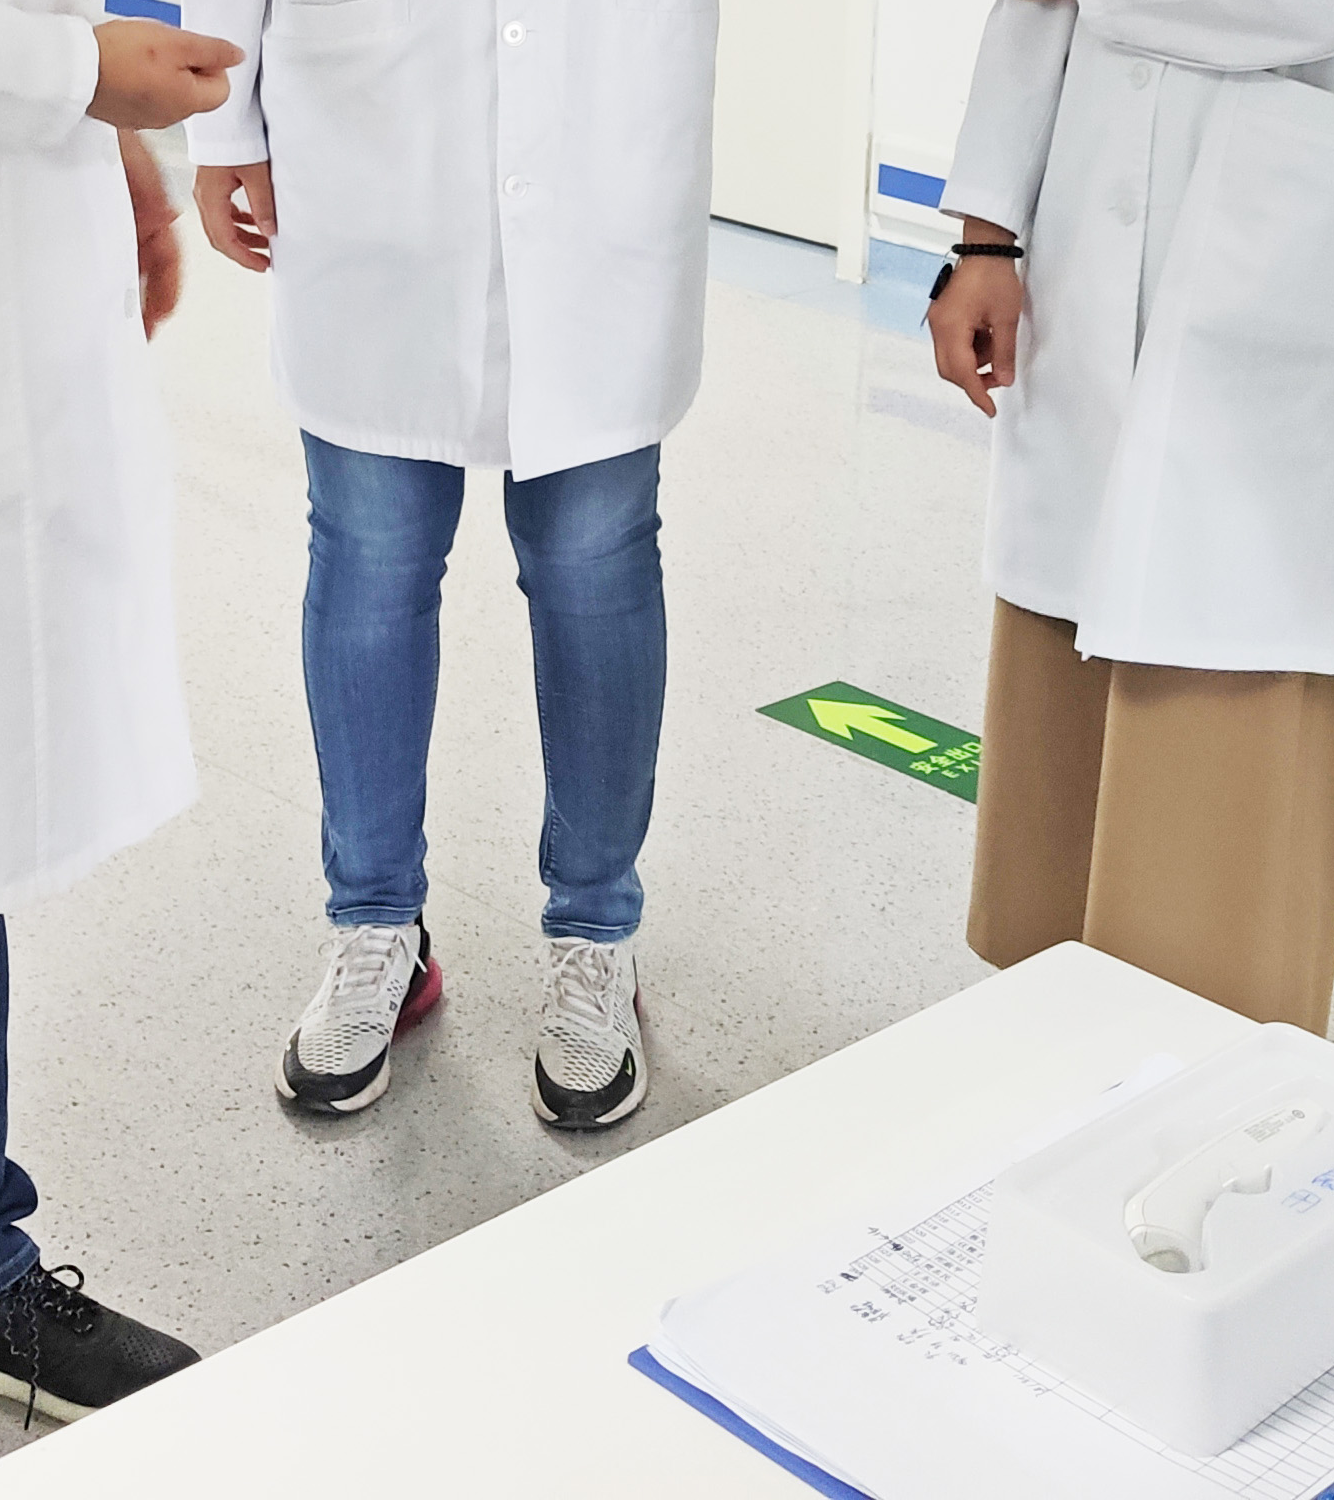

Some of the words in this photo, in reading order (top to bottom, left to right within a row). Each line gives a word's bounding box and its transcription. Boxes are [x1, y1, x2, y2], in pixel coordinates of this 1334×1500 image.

[909, 741, 983, 775] 安全出口
[941, 759, 981, 779] EXI
